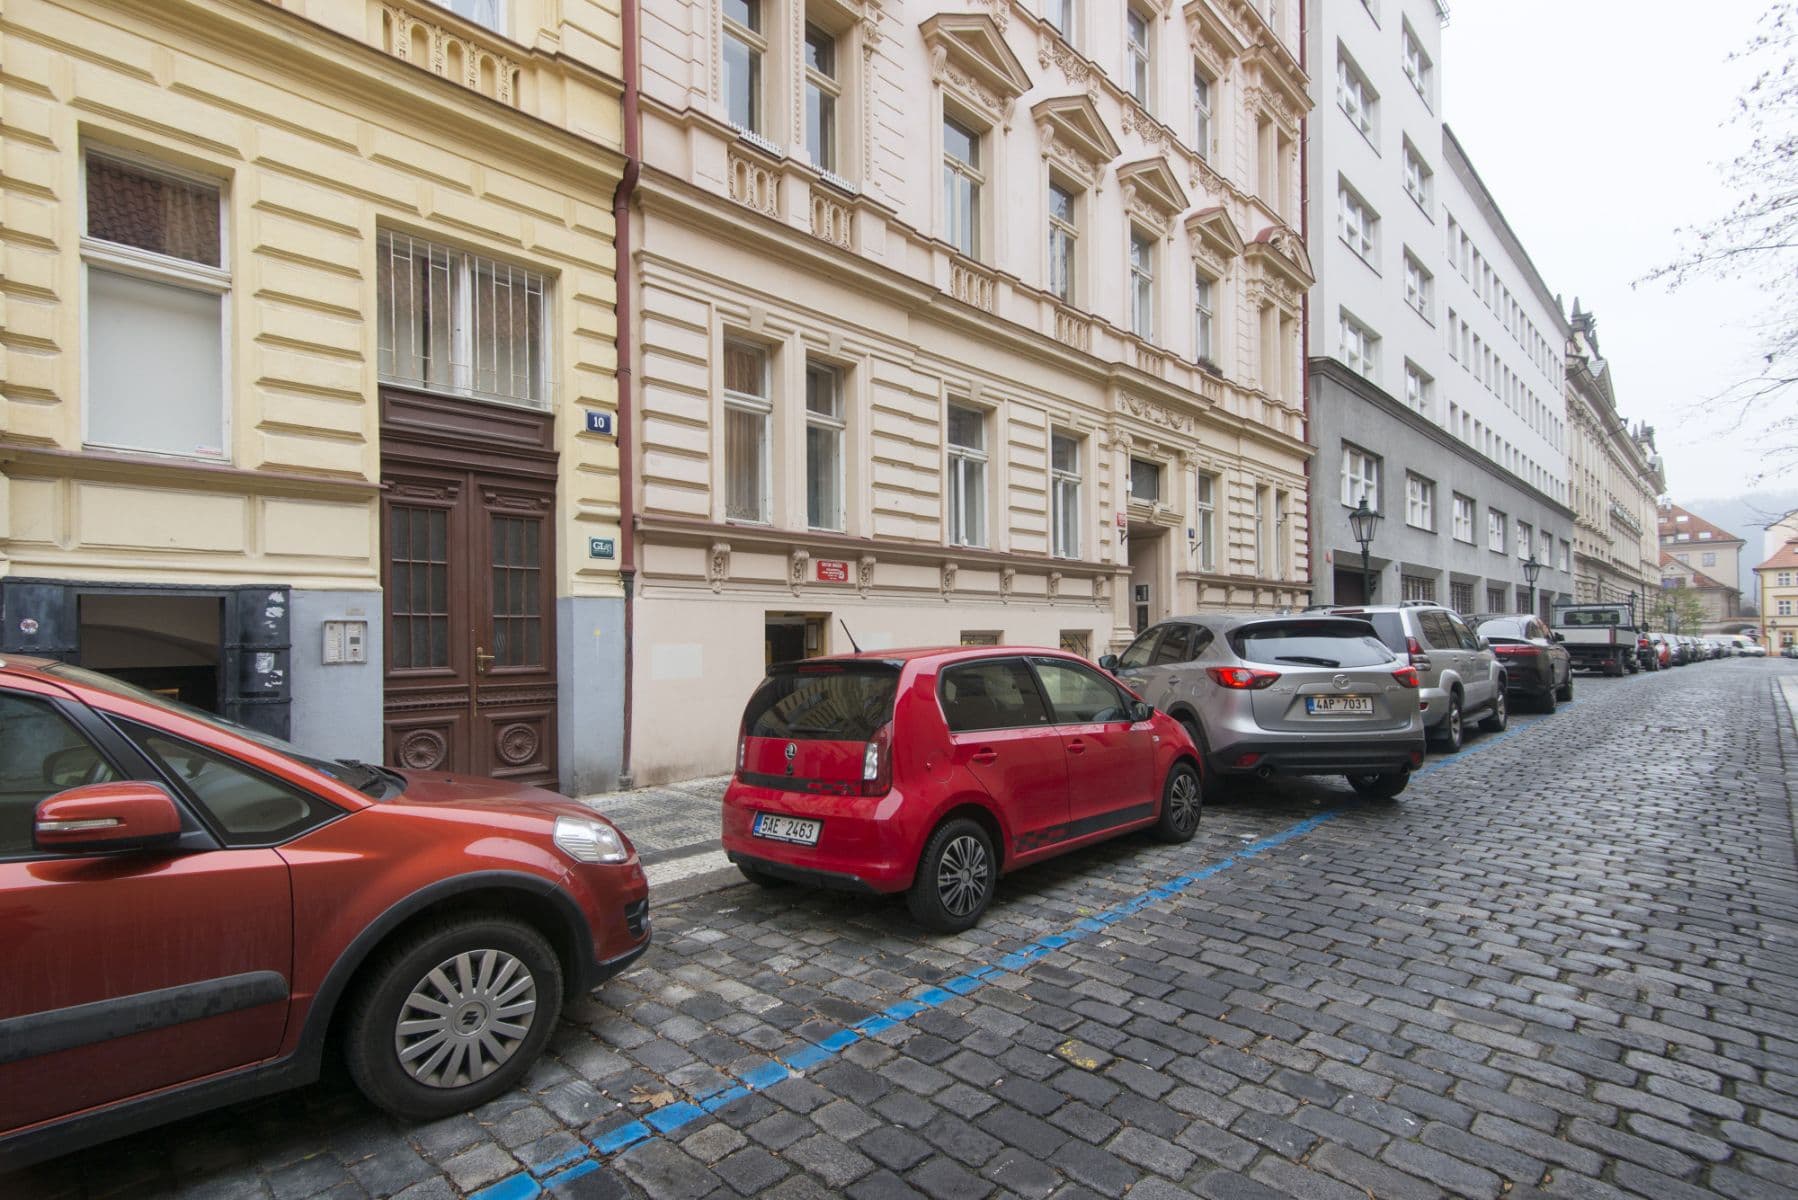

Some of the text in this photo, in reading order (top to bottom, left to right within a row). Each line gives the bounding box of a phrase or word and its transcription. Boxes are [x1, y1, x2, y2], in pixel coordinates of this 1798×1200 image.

[593, 416, 605, 429] 10
[1316, 698, 1368, 710] 4AP 7031
[761, 816, 781, 834] 5AE
[785, 820, 814, 839] 2463
